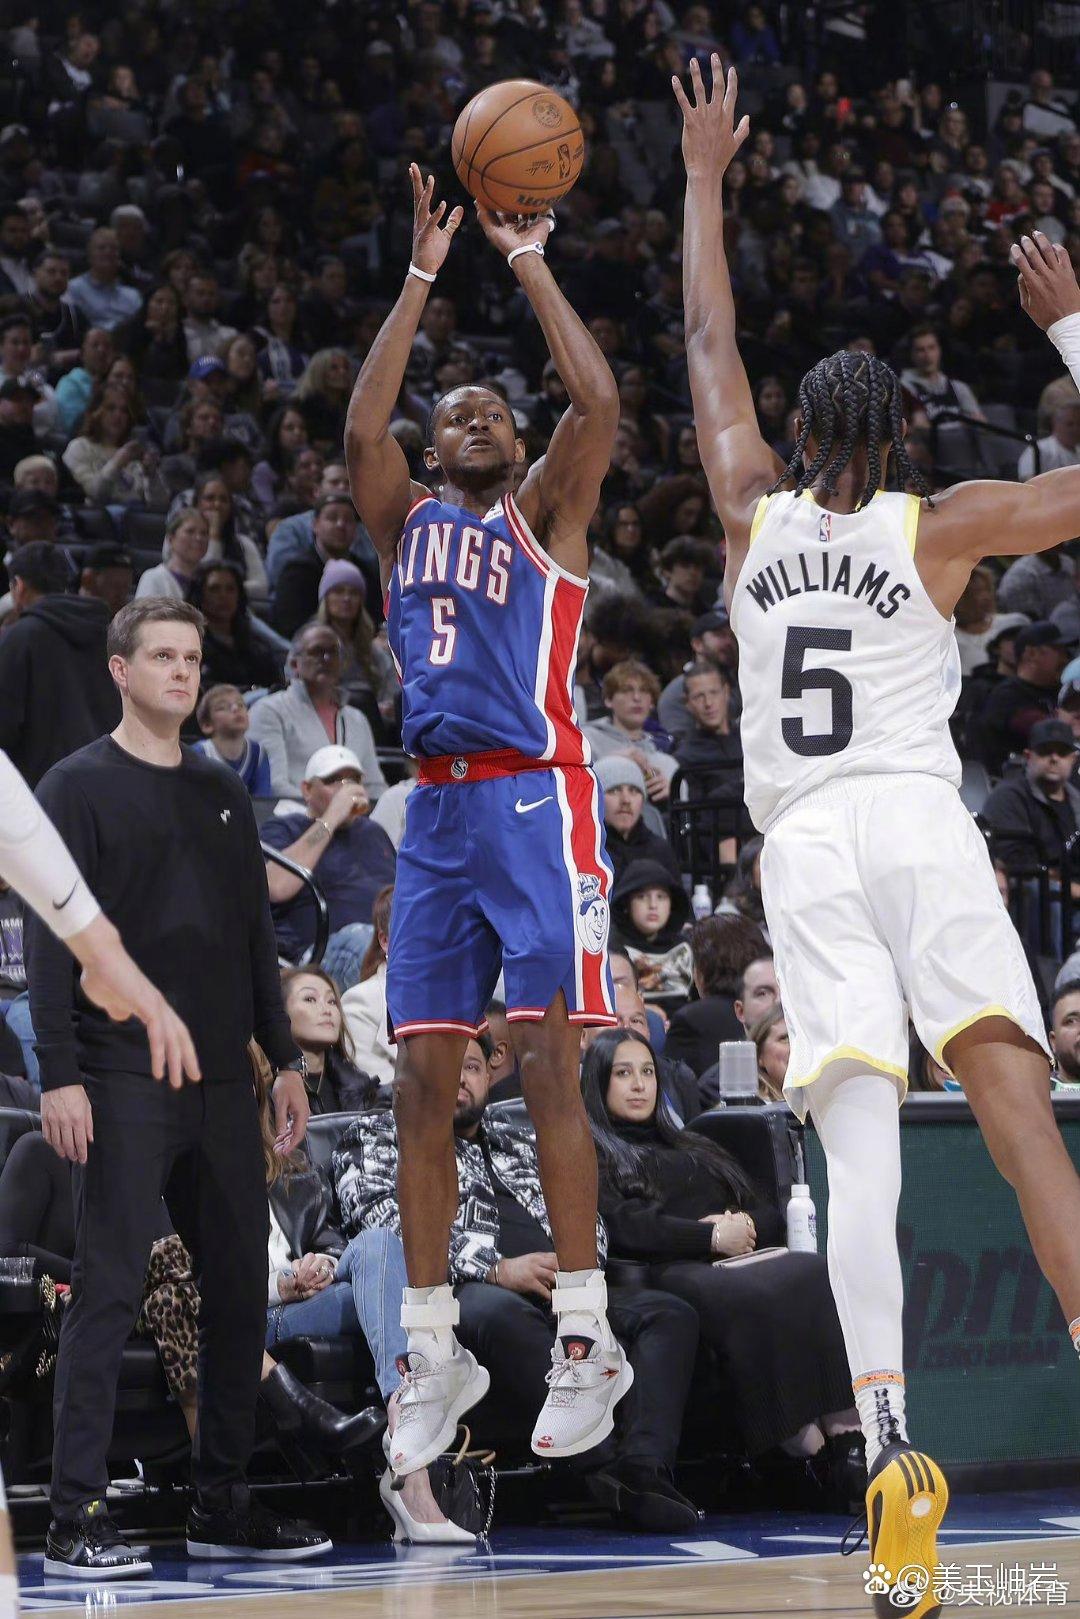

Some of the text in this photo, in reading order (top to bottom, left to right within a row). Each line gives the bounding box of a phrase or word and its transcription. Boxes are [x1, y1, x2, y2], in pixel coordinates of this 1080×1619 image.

[745, 551, 911, 619] WILLIAMS
[429, 597, 457, 666] 5
[780, 625, 854, 757] 5
